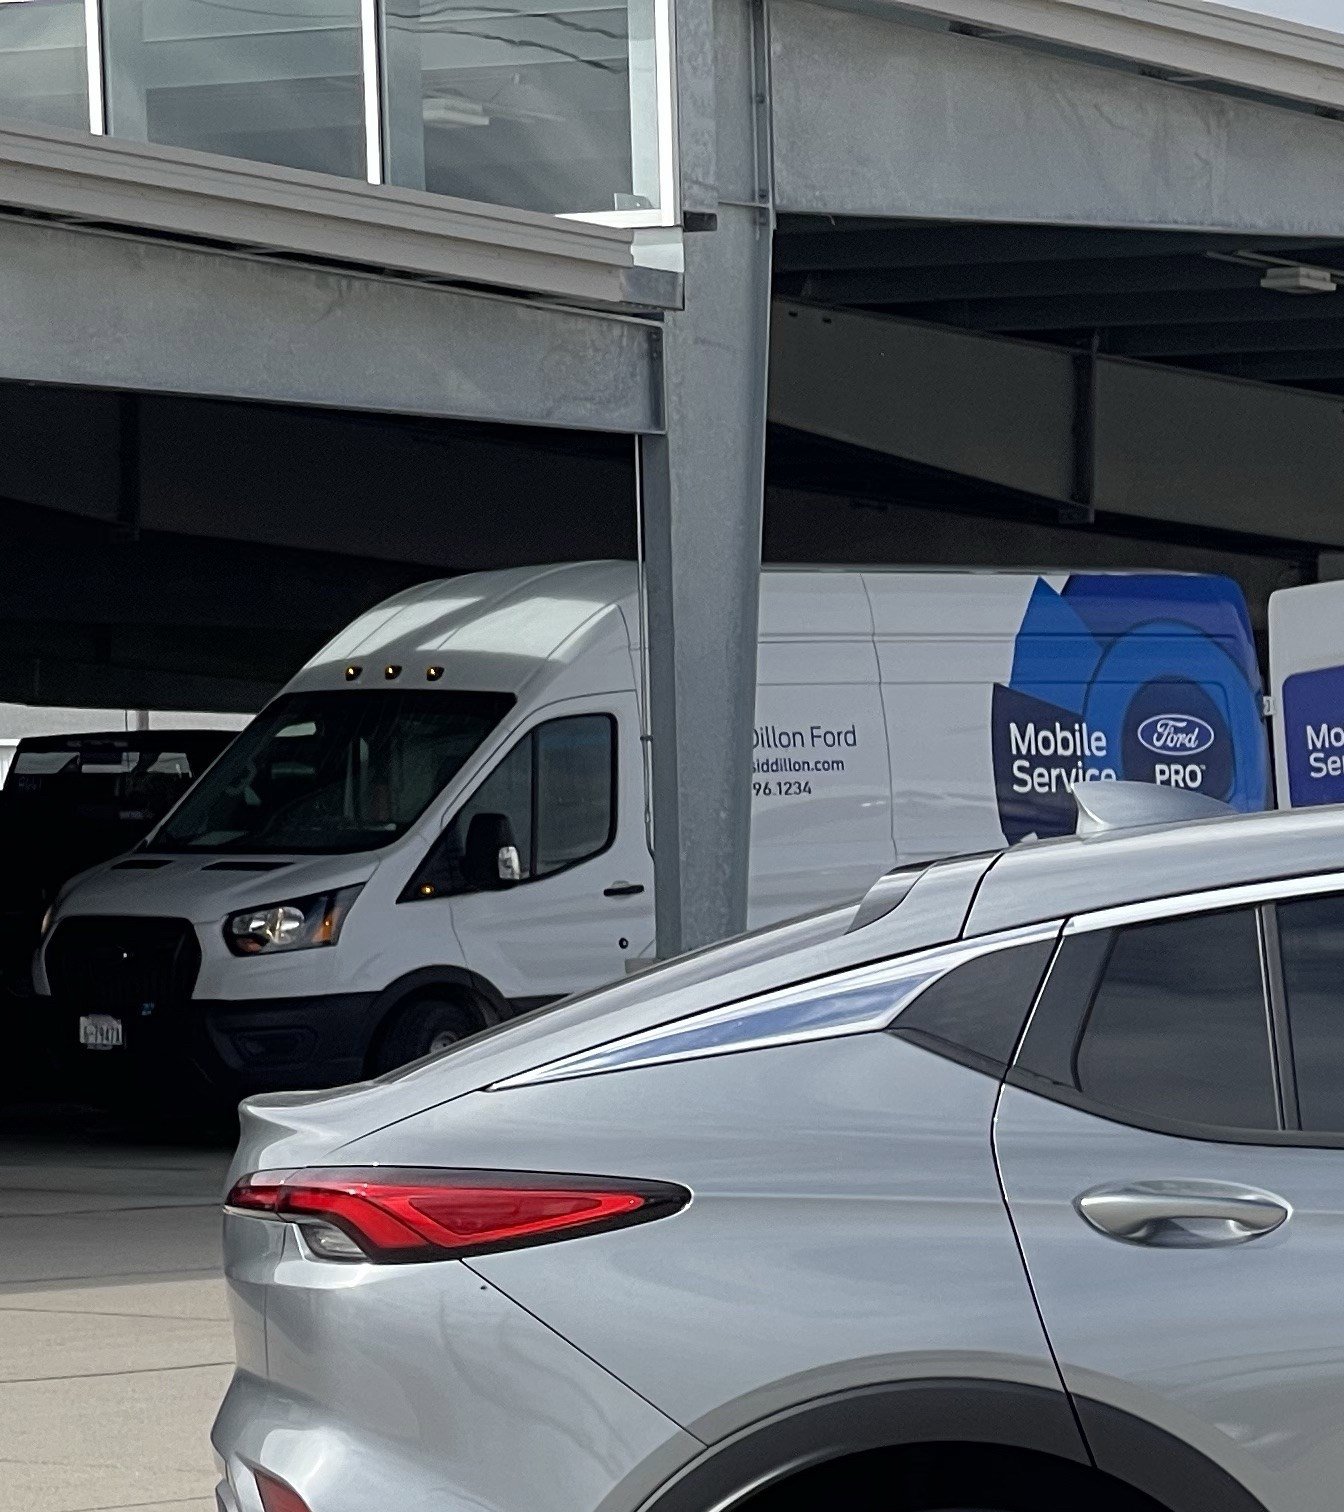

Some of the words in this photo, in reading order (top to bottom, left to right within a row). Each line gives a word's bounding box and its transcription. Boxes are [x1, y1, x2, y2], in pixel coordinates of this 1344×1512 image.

[809, 724, 857, 748] Ford
[1009, 721, 1107, 757] Mobile
[1152, 719, 1199, 748] Ford
